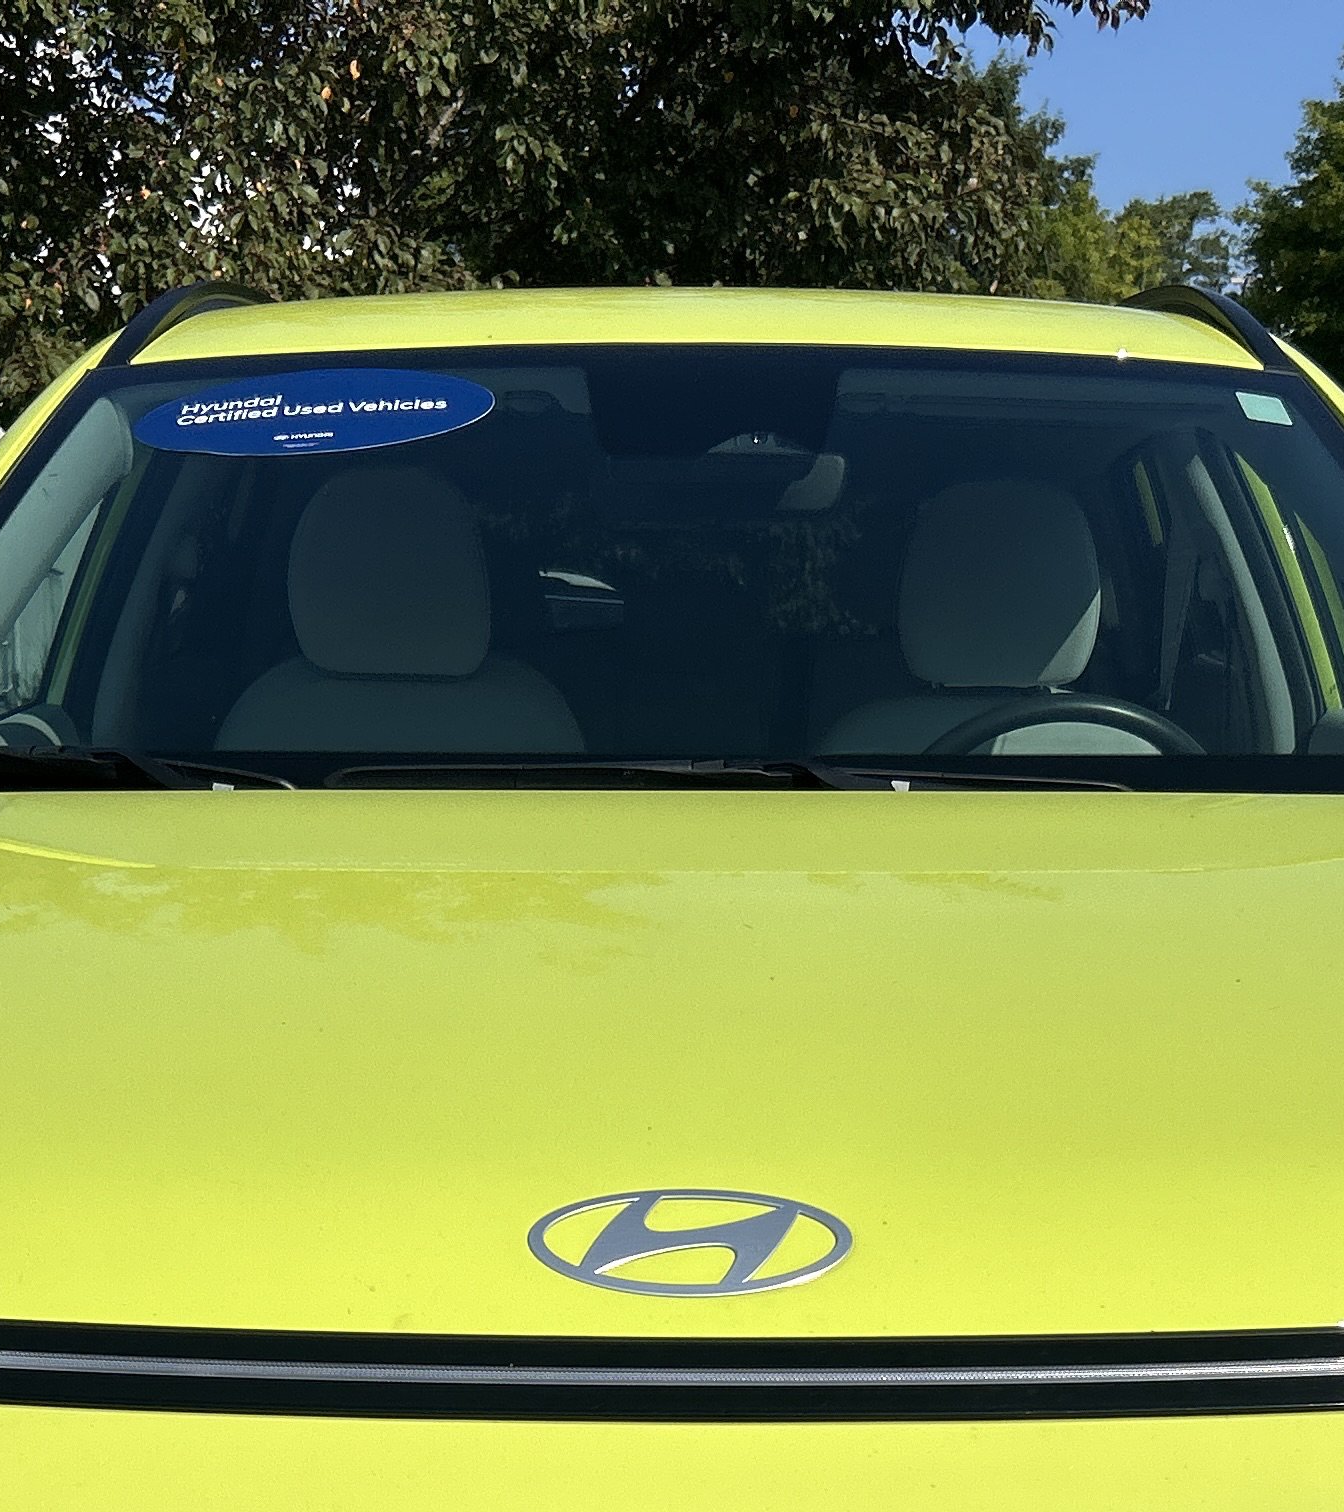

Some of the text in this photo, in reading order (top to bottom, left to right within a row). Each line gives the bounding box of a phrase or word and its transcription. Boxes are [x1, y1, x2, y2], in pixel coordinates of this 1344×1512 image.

[176, 398, 448, 426] Certified Used Vehicles
[181, 394, 283, 415] Hyundai
